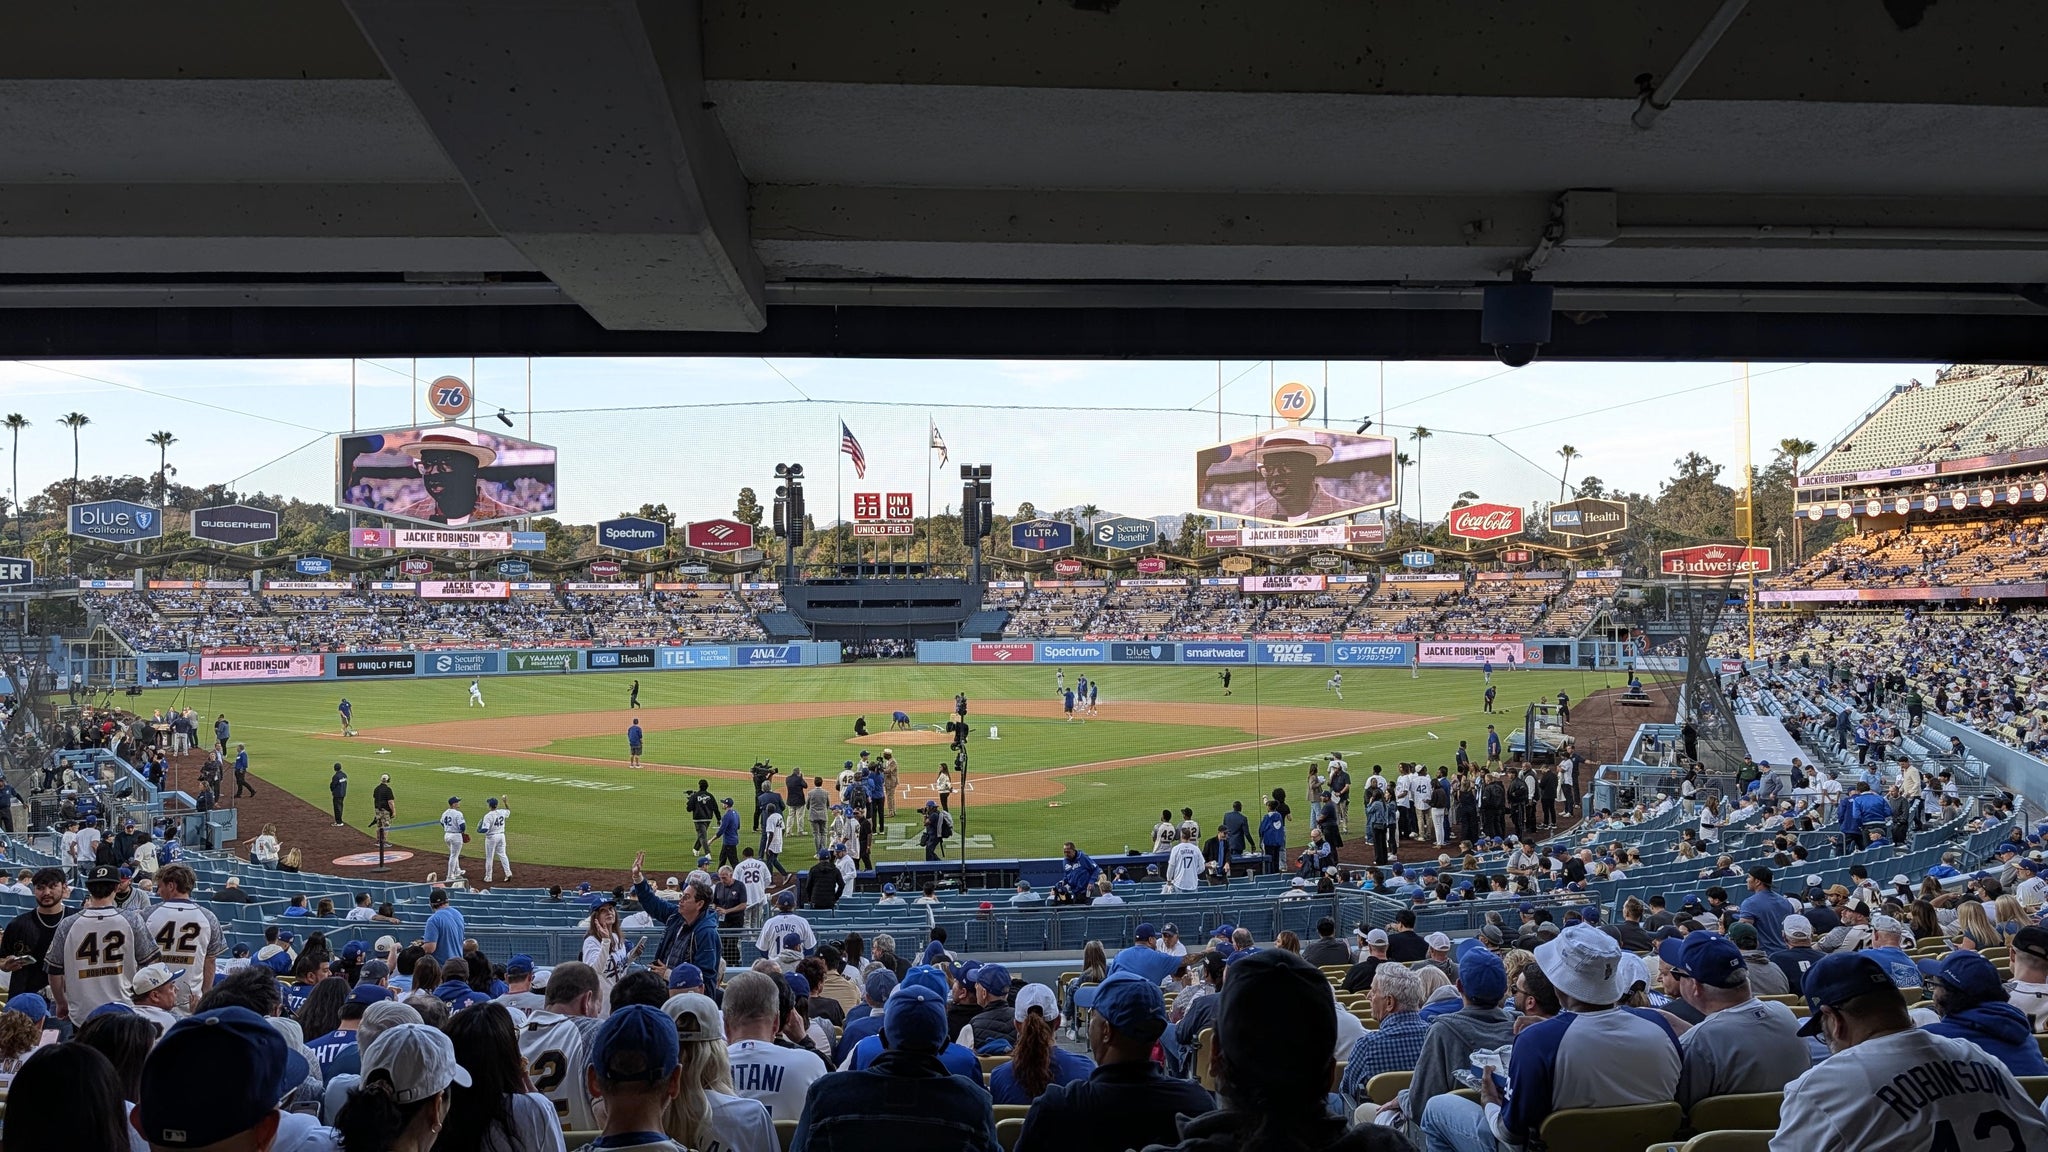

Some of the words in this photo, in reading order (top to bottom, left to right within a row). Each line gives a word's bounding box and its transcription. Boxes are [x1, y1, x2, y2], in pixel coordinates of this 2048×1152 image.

[436, 387, 464, 407] 76
[1281, 390, 1306, 410] 76
[1801, 477, 1825, 486] JACKIE
[1825, 473, 1856, 483] ROBINSON
[889, 496, 908, 505] UNI
[80, 508, 130, 526] blue
[889, 507, 910, 518] QLO
[1554, 515, 1579, 525] UCLA
[1584, 511, 1620, 522] Health
[201, 520, 272, 530] GUGGENHEIM
[857, 526, 886, 534] UNIQLO
[887, 526, 911, 534] FIELD
[1117, 525, 1150, 534] Security
[87, 527, 136, 535] california
[606, 528, 656, 540] Spectrum
[1025, 529, 1060, 537] ULTRA
[1249, 531, 1278, 541] JACKIE
[1278, 528, 1319, 540] ROBINSON
[403, 532, 436, 542] JACKIE
[436, 533, 480, 543] ROBINSON
[1117, 533, 1146, 542] Benefit
[1406, 554, 1432, 565] TEL
[406, 561, 428, 571] JINRO
[1672, 559, 1760, 572] Budweiser
[750, 649, 776, 659] ANA
[1045, 646, 1096, 659] Spectrum
[1126, 646, 1150, 656] blue
[1186, 648, 1246, 658] smartwater
[1266, 645, 1304, 654] TOYO
[1350, 646, 1402, 655] SYNCRON
[1424, 647, 1455, 656] JACKIE
[1454, 647, 1496, 656] ROBINSON
[1528, 650, 1540, 659] 76
[454, 654, 486, 664] Security
[621, 655, 650, 663] Health
[664, 651, 694, 665] TEL
[1272, 653, 1313, 663] TIRES
[208, 661, 243, 672] JACKIE
[243, 659, 290, 670] ROBINSON
[357, 661, 388, 670] UNIQLO
[388, 660, 413, 669] FIELD
[454, 663, 482, 672] Benefit
[180, 666, 196, 677] 76
[843, 775, 854, 784] 42
[1416, 784, 1427, 794] 42
[444, 815, 453, 827] 42
[494, 816, 505, 828] 42
[1161, 829, 1174, 841] 42
[1184, 856, 1193, 869] 17
[97, 868, 108, 878] D
[744, 870, 760, 884] 26
[775, 923, 797, 933] DAVIS
[156, 920, 201, 953] 42
[75, 930, 126, 966] 42
[1876, 1060, 2011, 1122] ROBINSON
